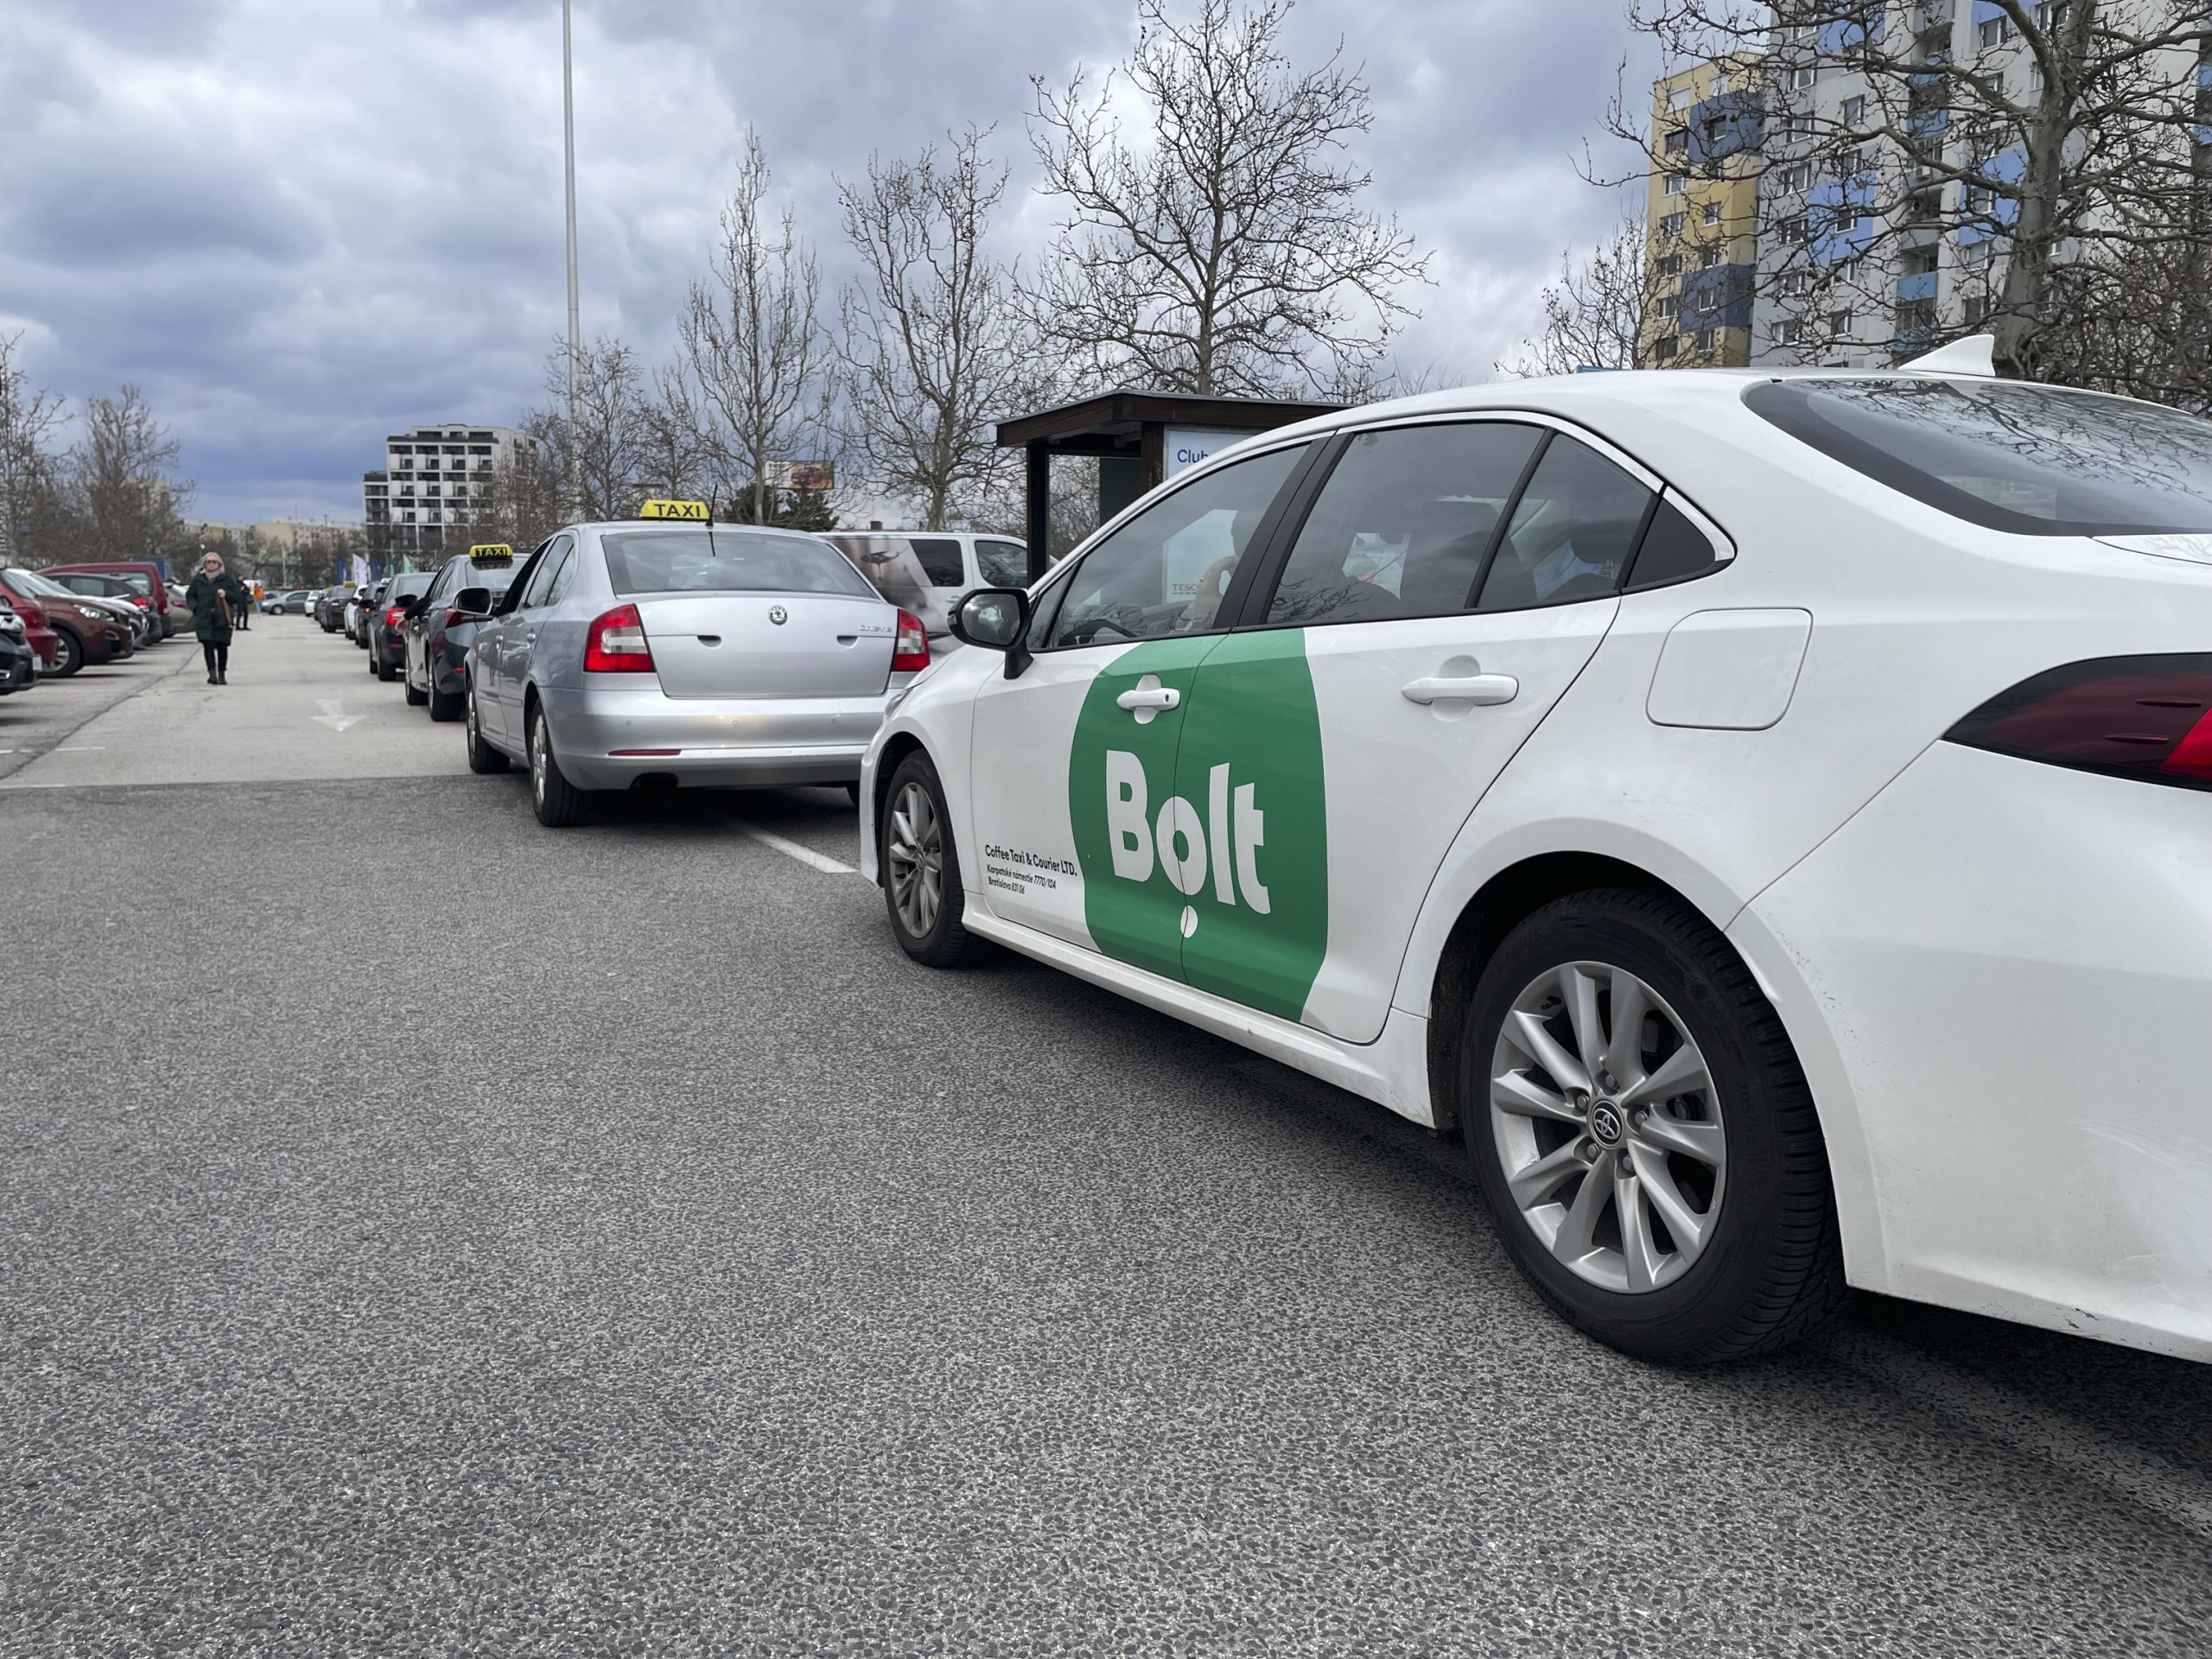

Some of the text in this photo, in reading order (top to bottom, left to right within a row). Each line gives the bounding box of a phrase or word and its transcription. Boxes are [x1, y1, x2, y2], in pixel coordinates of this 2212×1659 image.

[654, 504, 701, 518] TAXI
[476, 548, 506, 557] TAXI
[1172, 583, 1198, 592] TESC
[1106, 749, 1271, 914] Bolt
[985, 844, 1077, 877] Coffee Taxi & Courier LTD.
[988, 875, 1011, 890] Bratislava
[1019, 884, 1026, 894] 06
